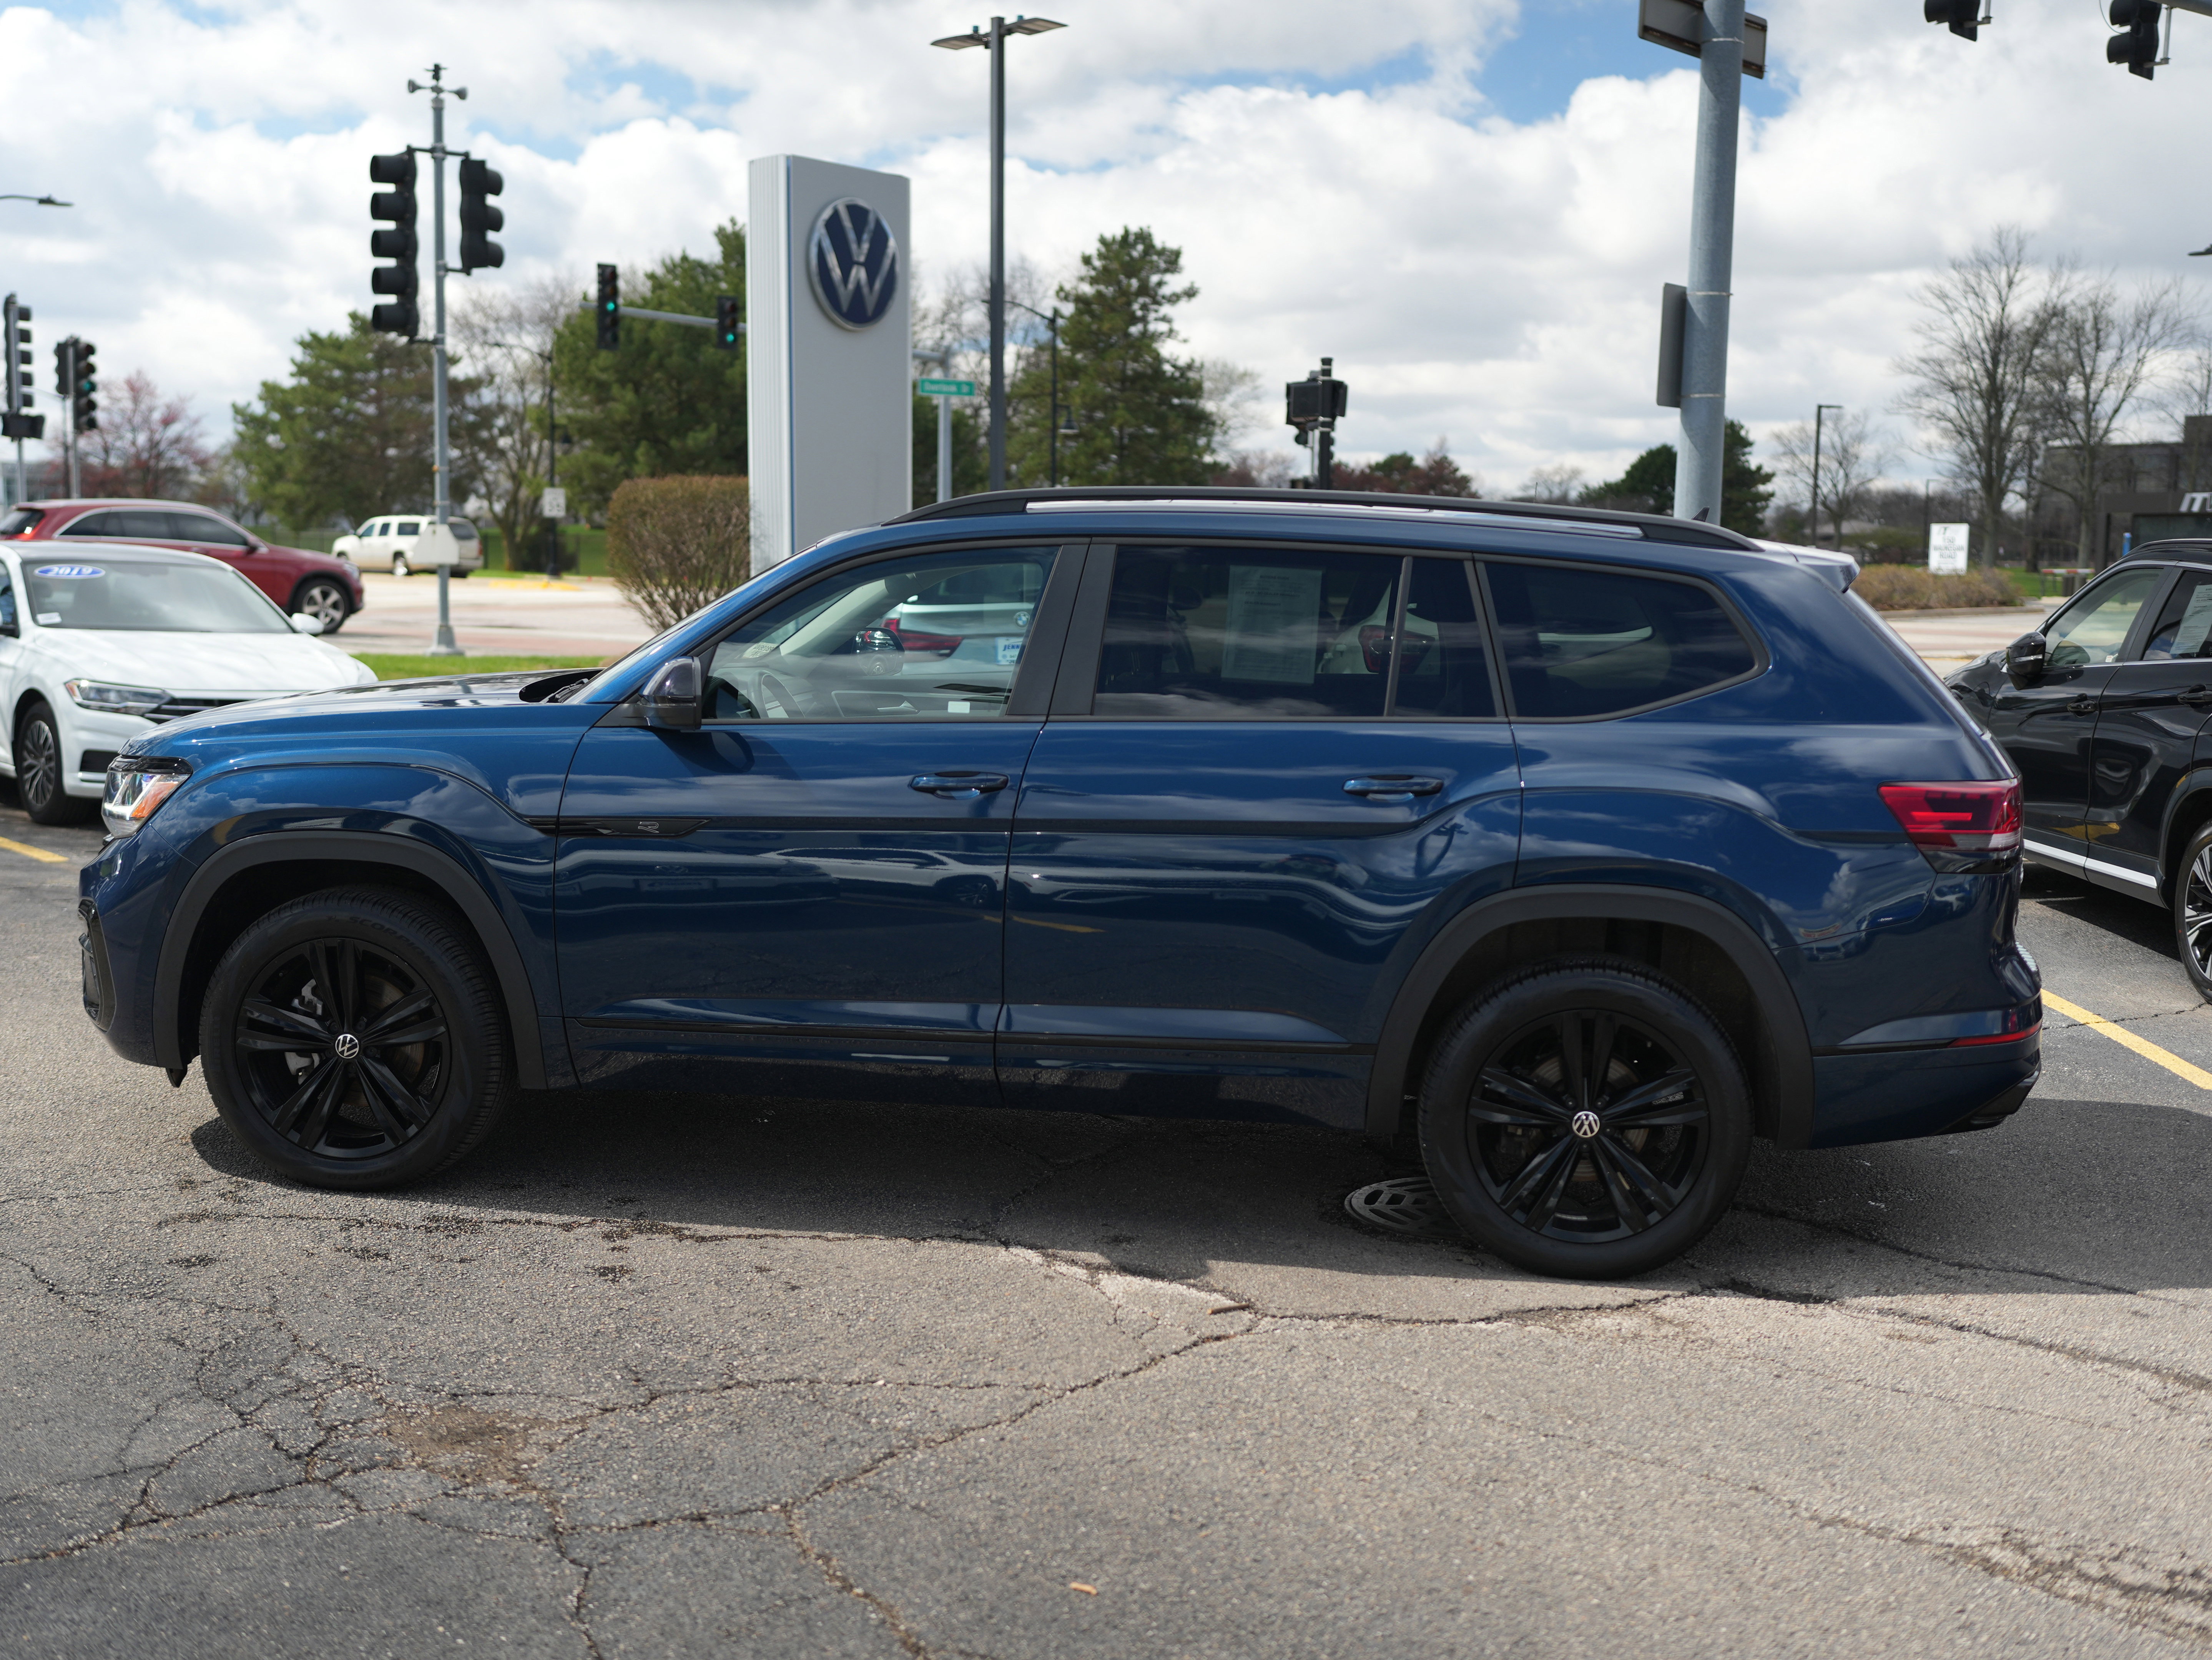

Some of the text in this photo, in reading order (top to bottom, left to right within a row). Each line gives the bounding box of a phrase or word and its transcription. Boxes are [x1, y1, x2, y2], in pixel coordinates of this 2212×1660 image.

[810, 198, 899, 327] VW
[2179, 492, 2212, 513] IT
[48, 566, 93, 576] 2019
[638, 821, 659, 833] R
[347, 916, 437, 968] SCORPION
[336, 1034, 359, 1059] VW
